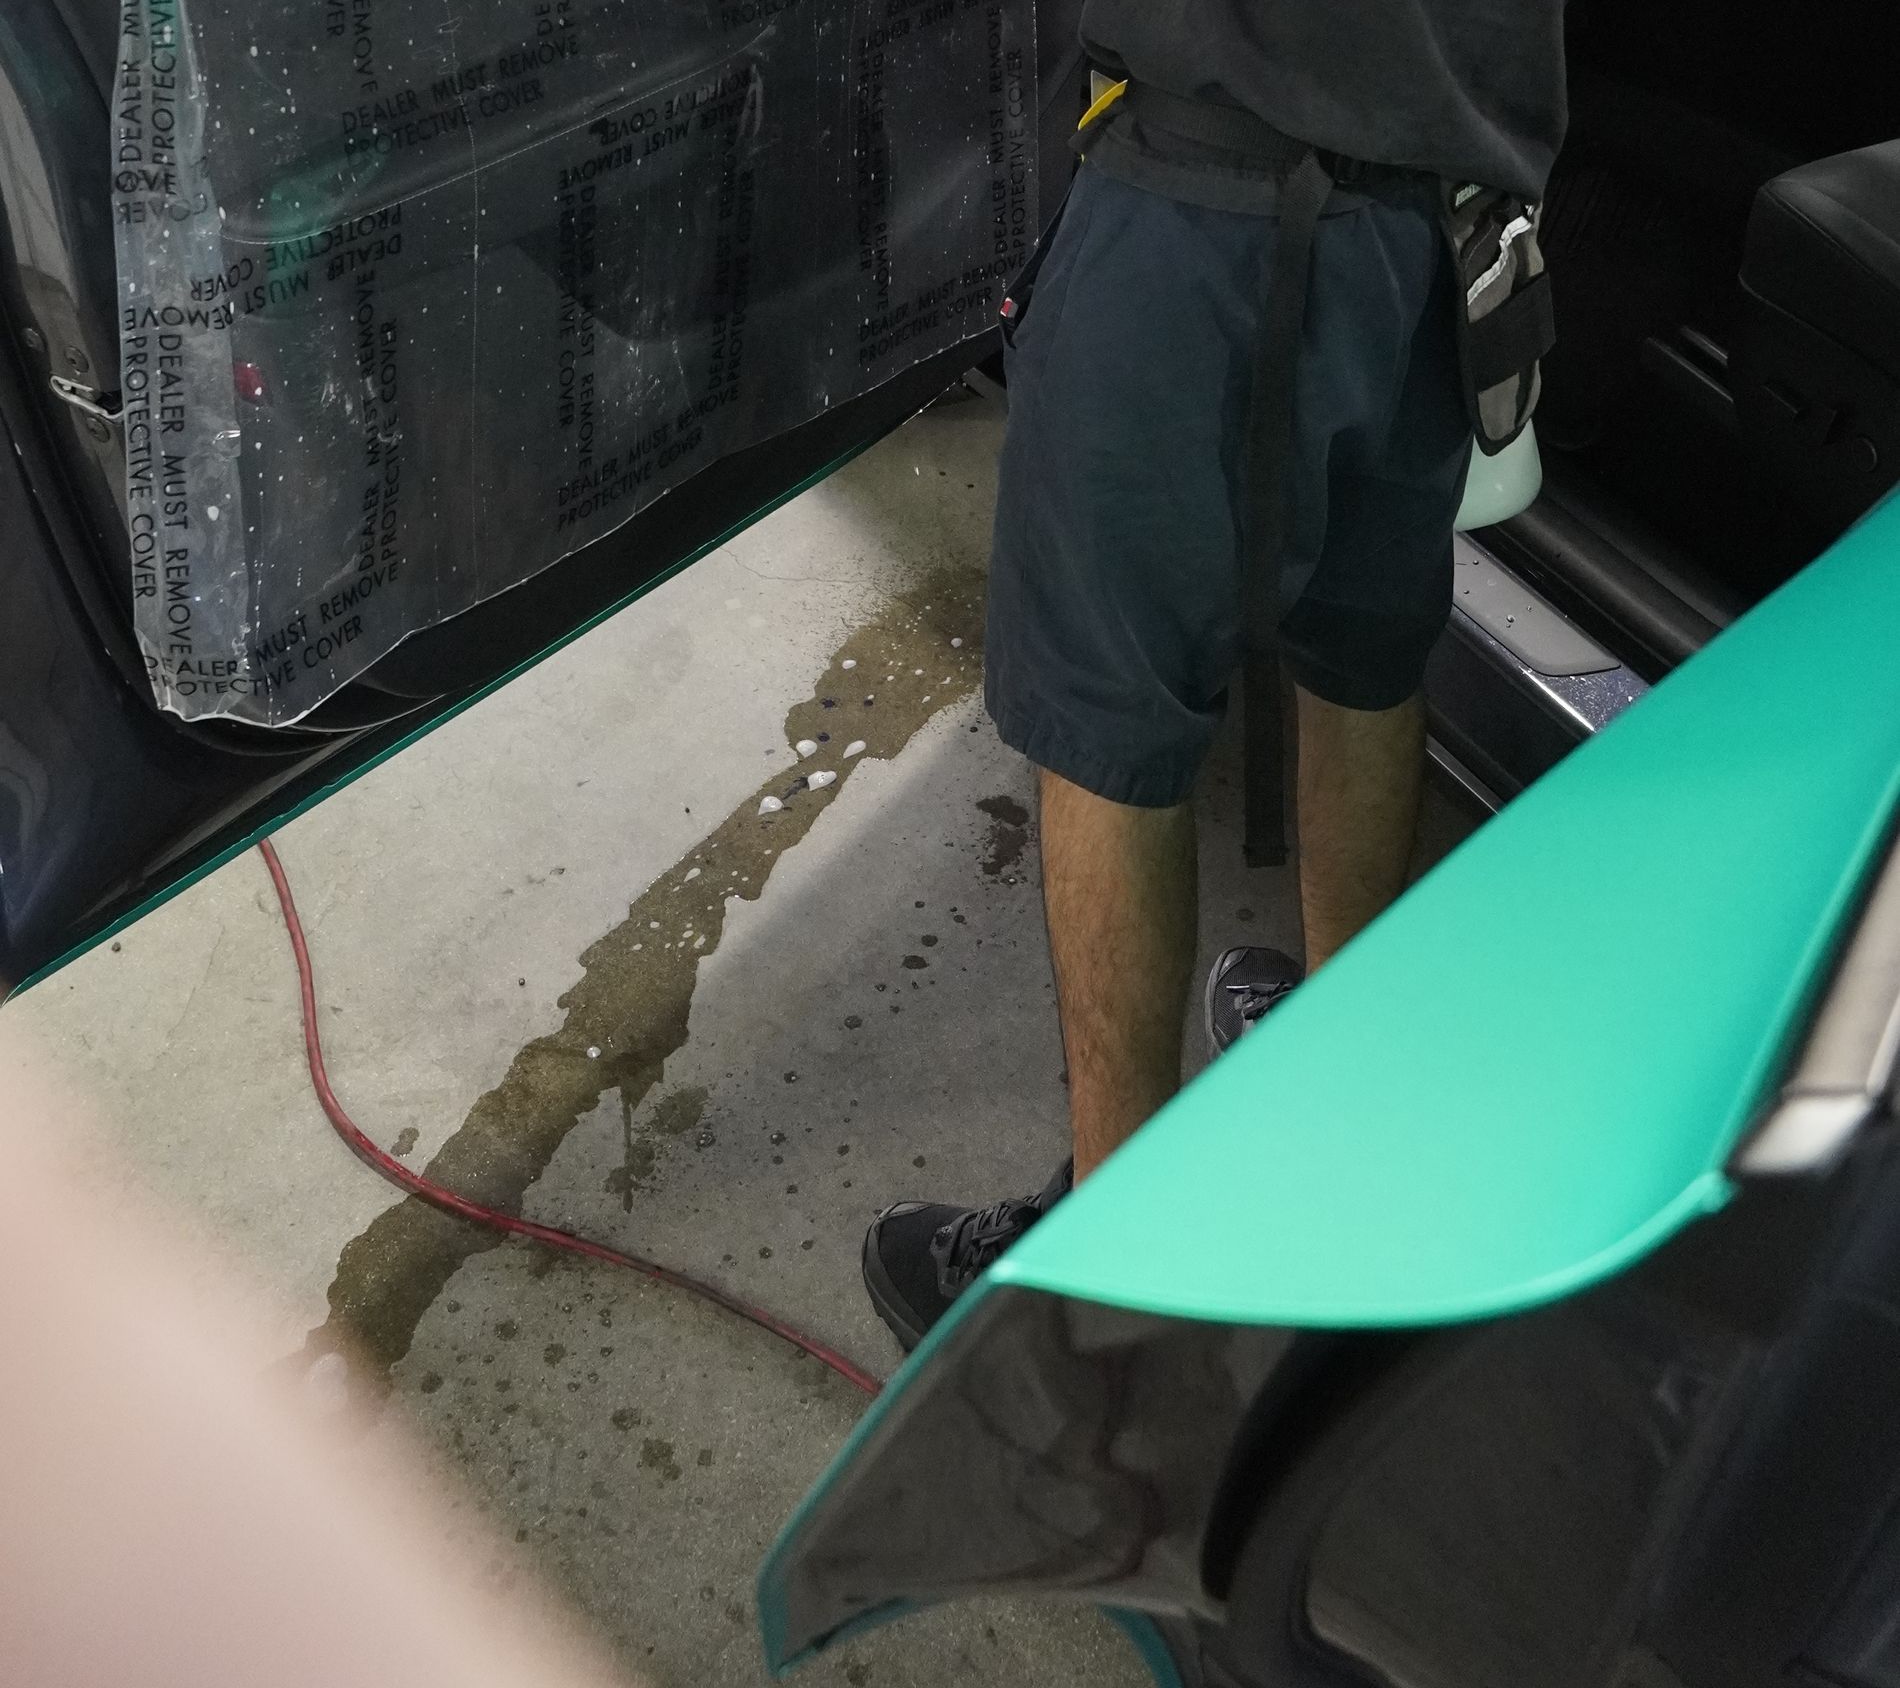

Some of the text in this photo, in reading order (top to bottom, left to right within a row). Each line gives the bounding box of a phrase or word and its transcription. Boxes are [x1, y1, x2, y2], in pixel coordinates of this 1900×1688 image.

[119, 60, 143, 163] DEALER
[341, 34, 579, 135] DEALER MUST REMOVE
[479, 79, 545, 117] COVER
[601, 108, 658, 146] COVER
[987, 6, 1009, 255] DEALER MUST REMOVE
[559, 143, 633, 190] REMOVE
[643, 119, 690, 156] MUST
[1006, 47, 1026, 250] PROTECTIVE COVER
[124, 233, 403, 331] DEALER MUST REMOVE
[190, 203, 403, 301] PROTECTIVE COVER
[874, 222, 890, 312] REMOVE
[918, 278, 957, 311] MUST
[962, 251, 1027, 288] REMOVE
[379, 317, 398, 403] COVER
[859, 309, 940, 365] PROTECTIVE
[558, 350, 576, 429] COVER
[578, 372, 595, 469] REMOVE
[126, 336, 157, 600] PROTECTIVE COVER
[159, 334, 193, 655] DEALER MUST REMOVE
[558, 426, 703, 531] PROTECTIVE COVER
[559, 386, 740, 506] DEALER MUST REMOVE
[358, 481, 380, 572] DEALER
[256, 614, 308, 664] MUST
[319, 562, 399, 625] REMOVE
[302, 615, 363, 669] COVER
